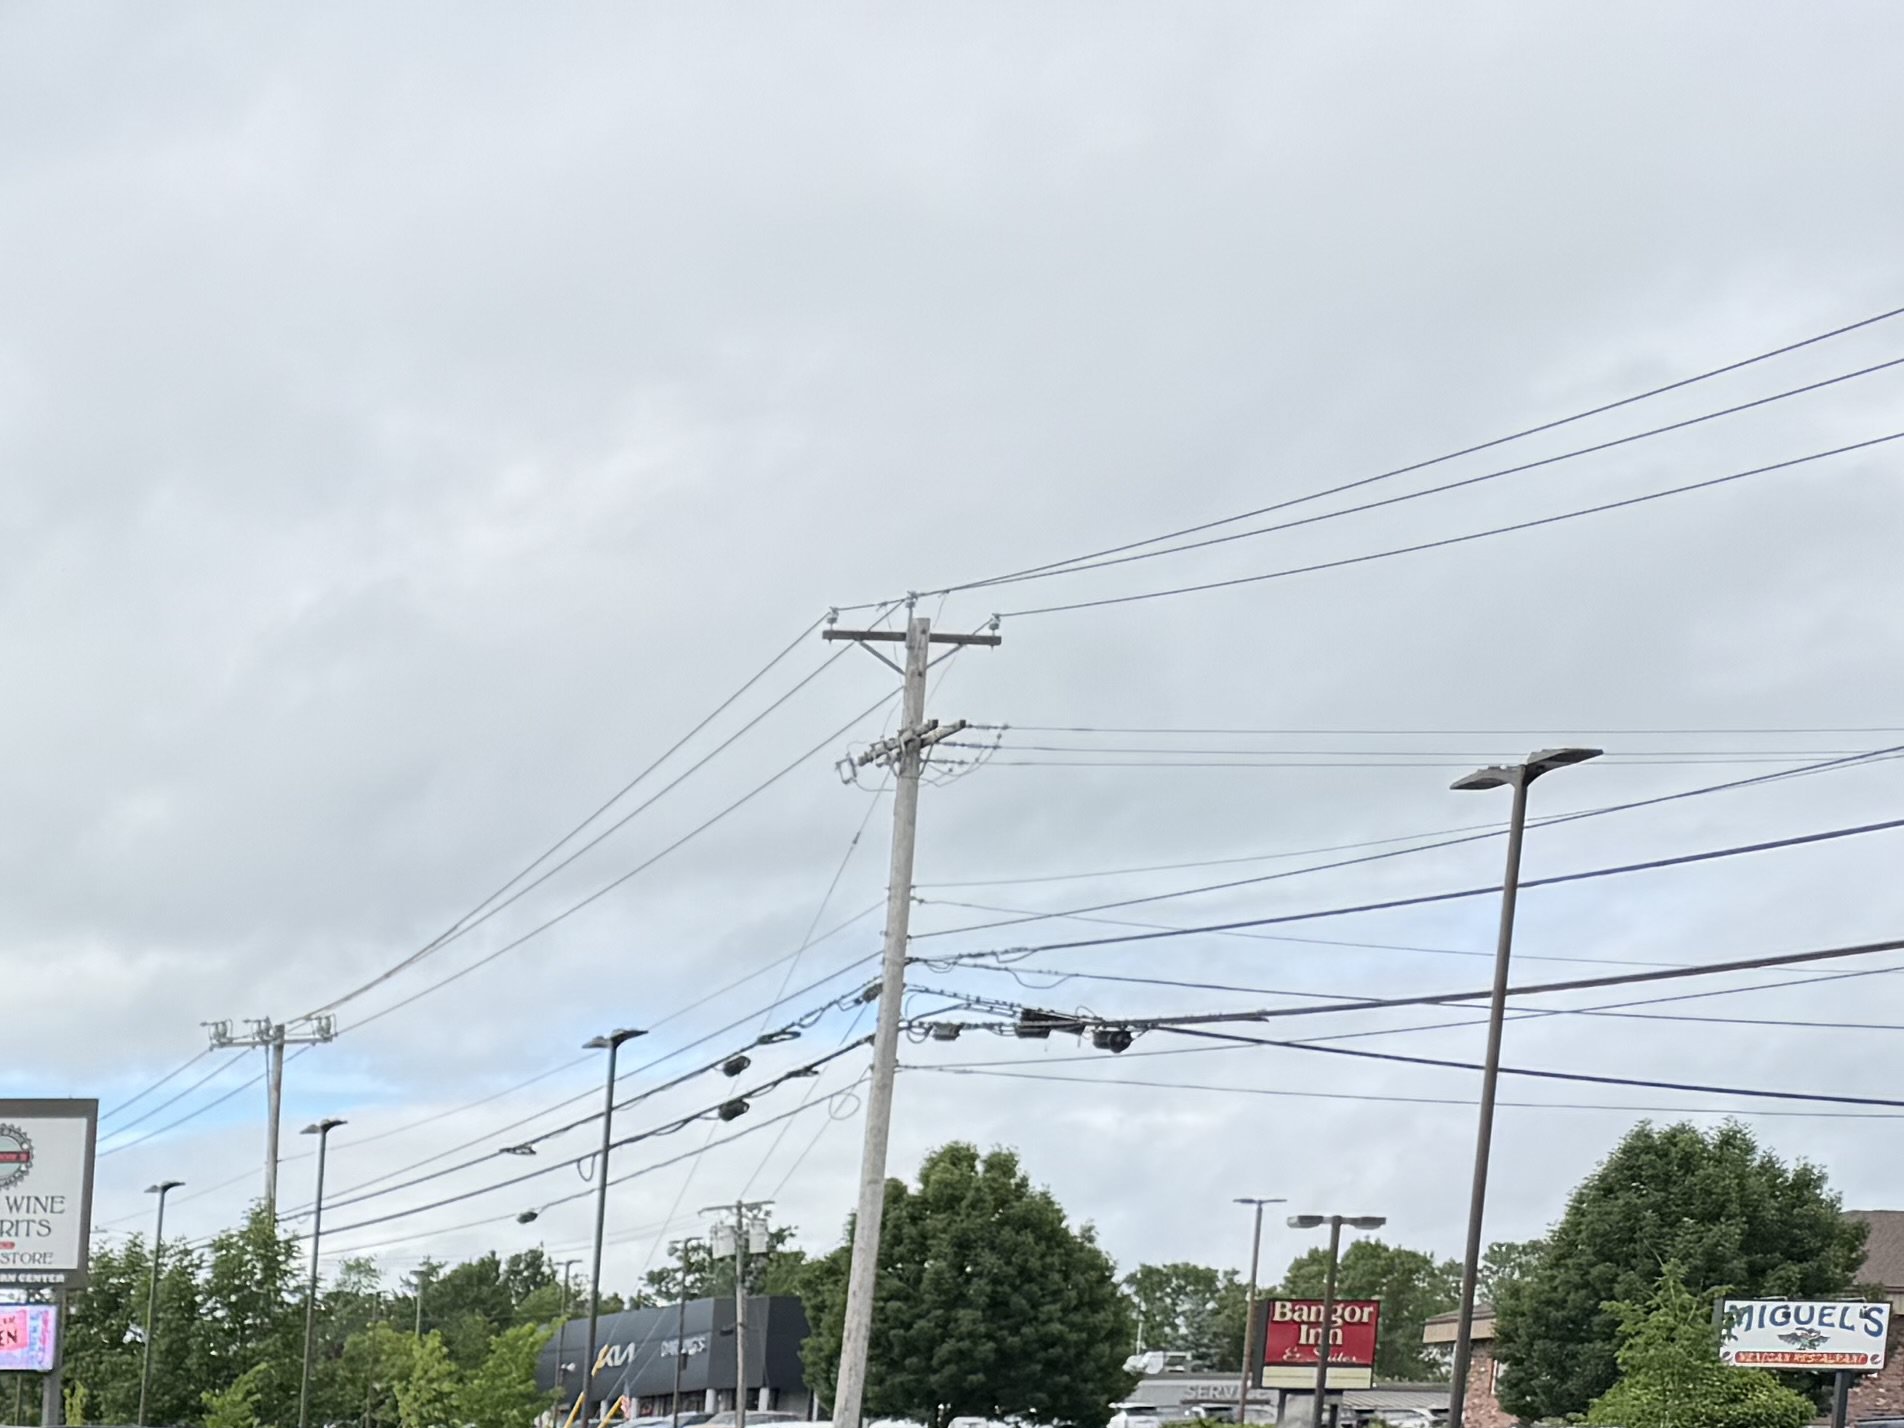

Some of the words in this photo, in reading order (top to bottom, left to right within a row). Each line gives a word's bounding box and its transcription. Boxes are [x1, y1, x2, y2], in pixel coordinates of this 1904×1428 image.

[5, 1195, 66, 1214] WINE
[0, 1252, 54, 1265] STORE
[18, 1273, 65, 1284] CENTER
[1273, 1301, 1374, 1327] Bangor
[1729, 1304, 1884, 1338] MIGUEL'S
[1298, 1324, 1343, 1345] Inn
